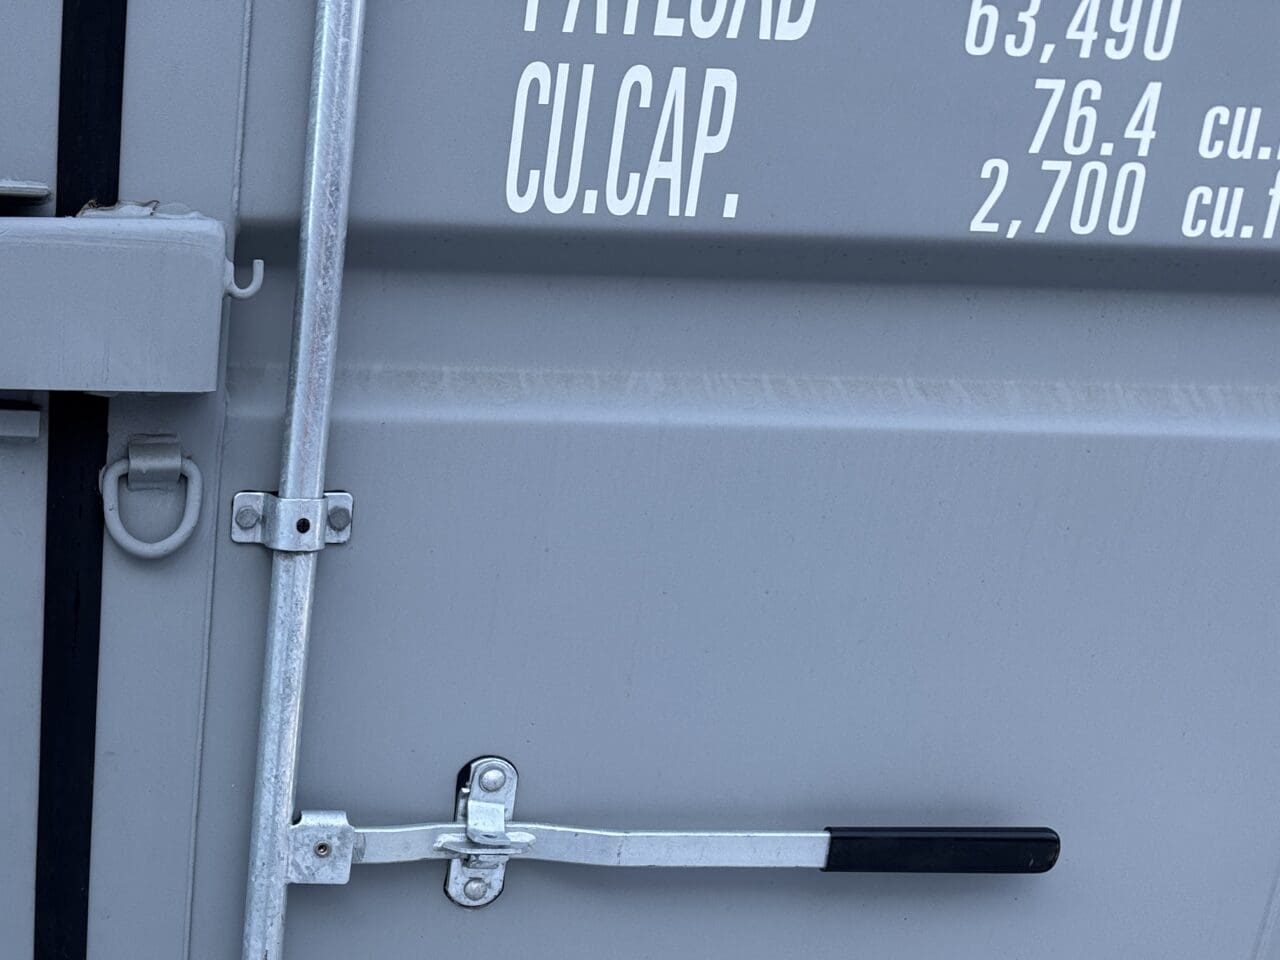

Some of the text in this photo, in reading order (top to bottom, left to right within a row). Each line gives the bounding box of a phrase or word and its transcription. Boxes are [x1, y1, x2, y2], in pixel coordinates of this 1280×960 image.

[963, 0, 1183, 64] 63,490
[505, 61, 740, 219] CU.CAP.
[1027, 78, 1280, 160] 76.4 cu.
[969, 158, 1146, 239] 2,700
